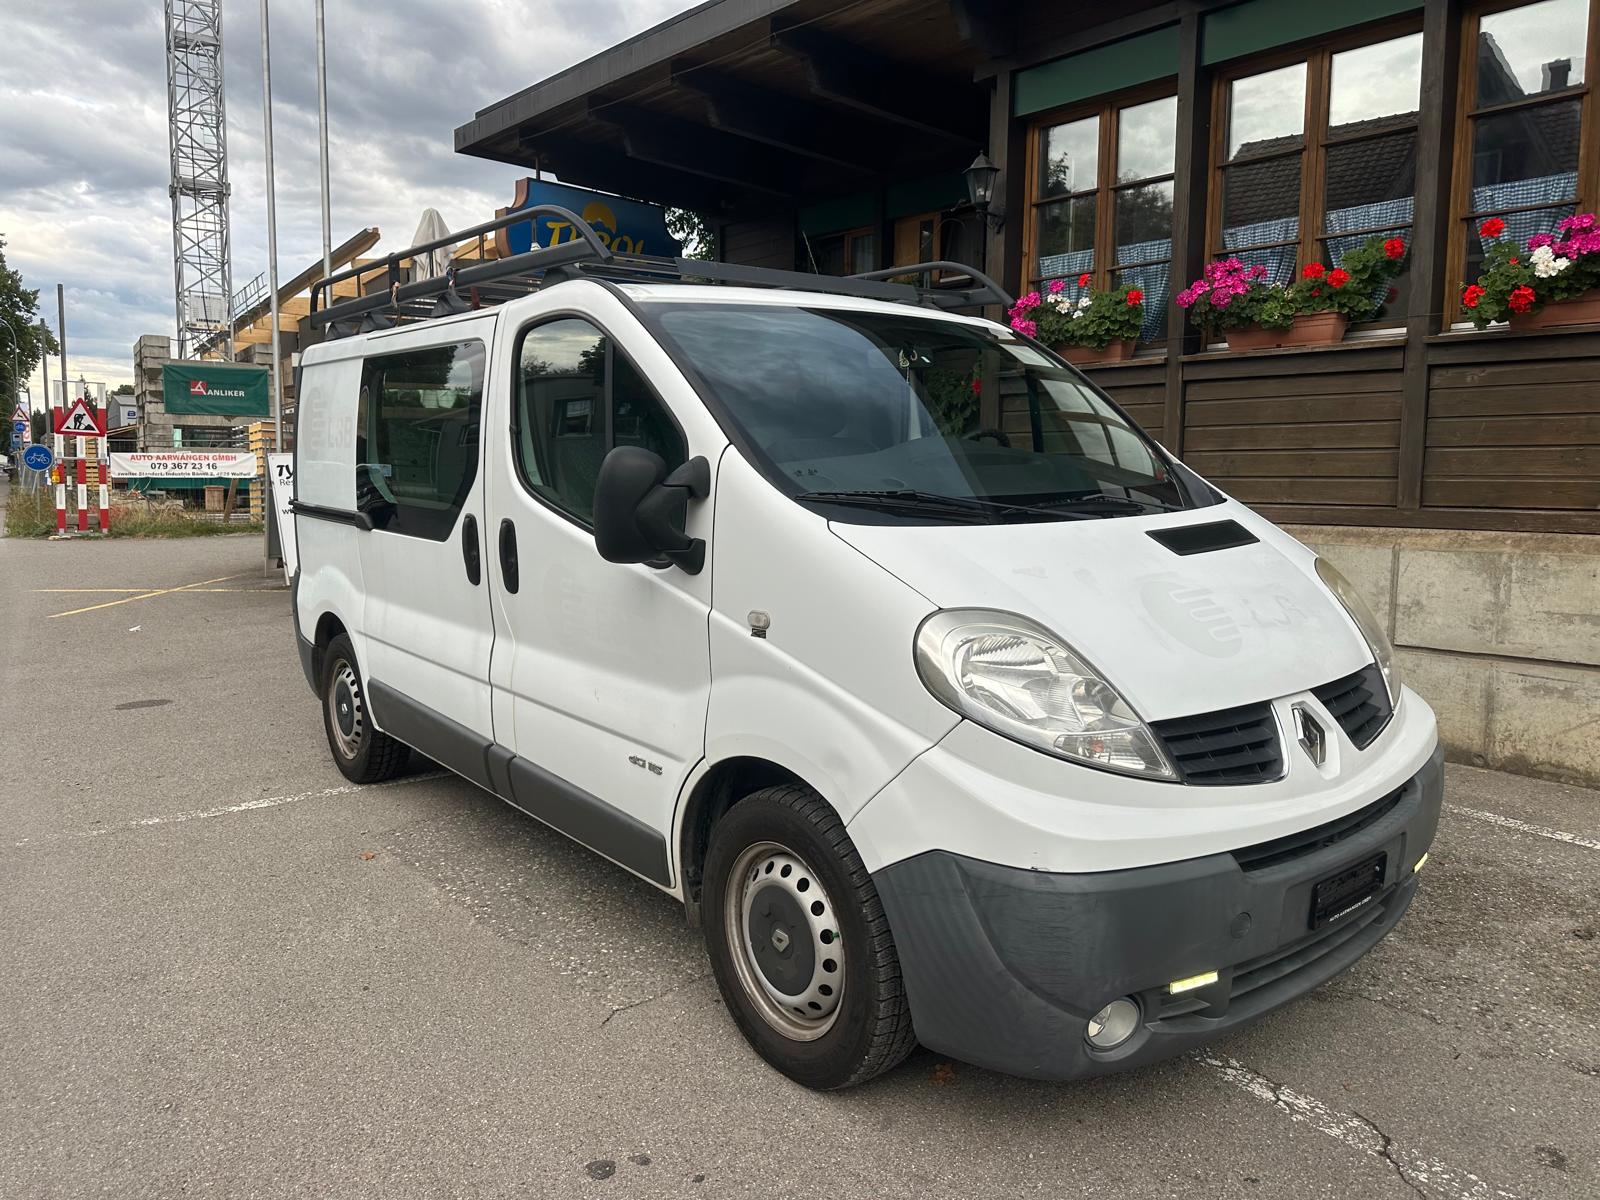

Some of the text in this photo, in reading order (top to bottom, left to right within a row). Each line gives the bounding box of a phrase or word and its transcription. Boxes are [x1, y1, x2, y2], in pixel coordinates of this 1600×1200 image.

[207, 389, 245, 397] ANLIKER
[150, 462, 218, 470] 079 367 23 16
